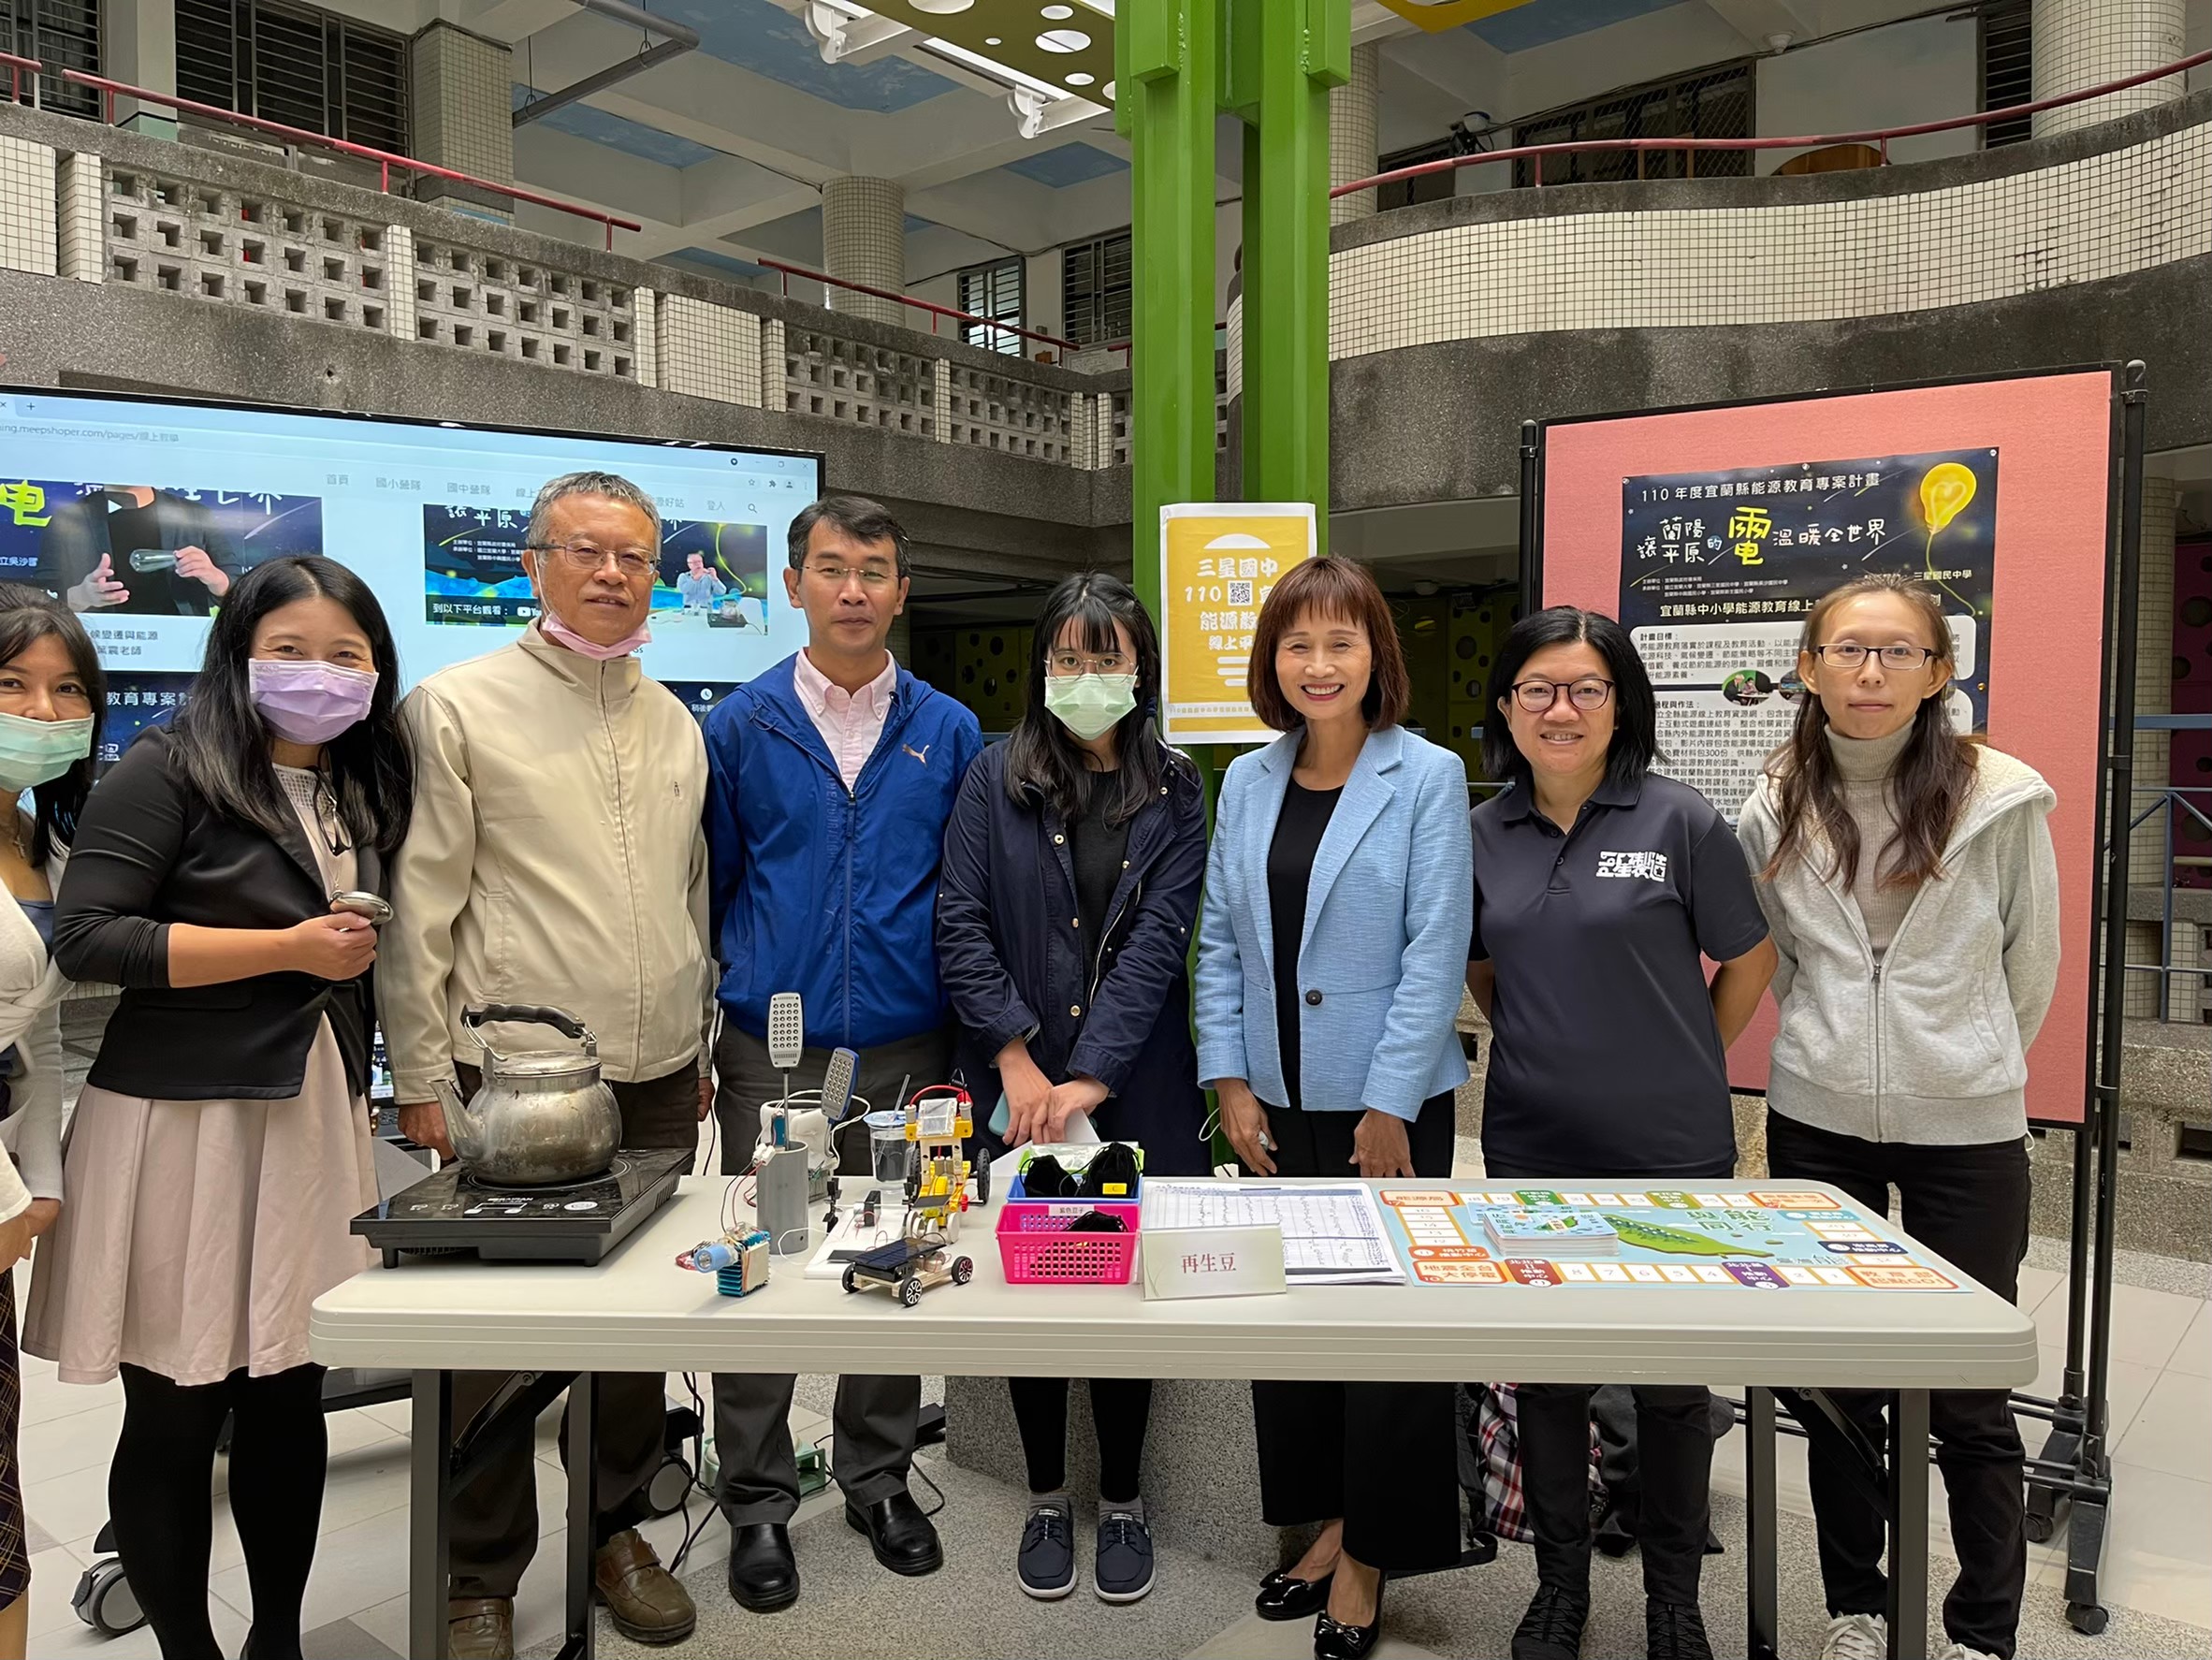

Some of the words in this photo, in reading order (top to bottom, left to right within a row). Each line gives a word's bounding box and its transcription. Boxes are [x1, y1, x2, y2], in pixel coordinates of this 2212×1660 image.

[1642, 488, 1669, 502] 110
[1675, 473, 1880, 501] 年度宜蘭縣能源教育專案計畫
[1196, 558, 1278, 578] 三星國中
[1914, 569, 1972, 581] 三星國民中學
[1184, 586, 1222, 603] 110
[1660, 599, 1813, 618] 宜蘭縣中小學能源教育線上
[1181, 1252, 1237, 1274] 再生豆
